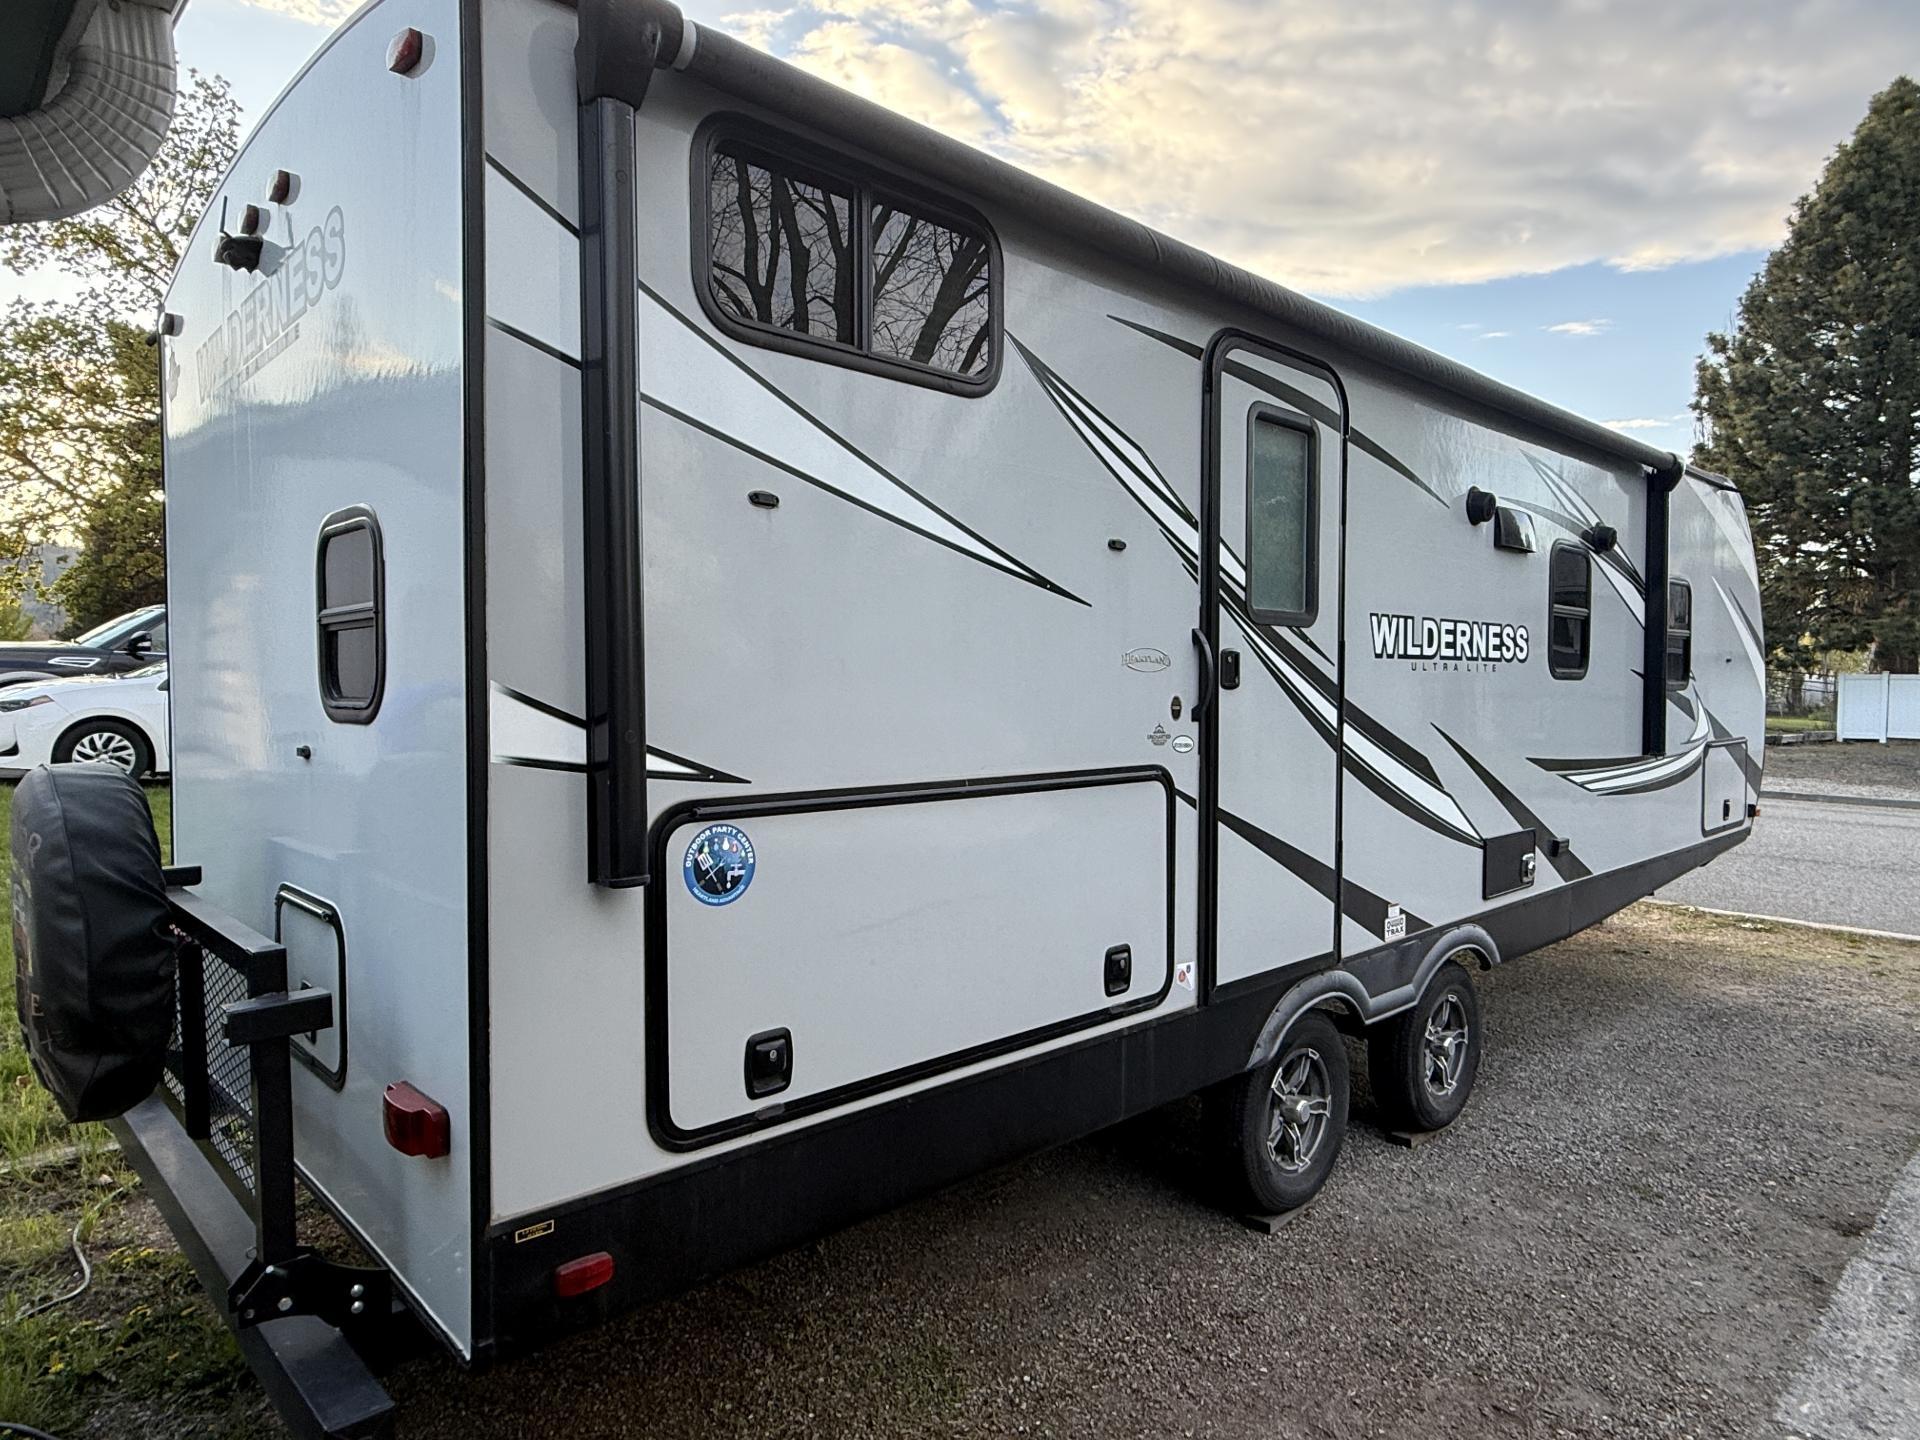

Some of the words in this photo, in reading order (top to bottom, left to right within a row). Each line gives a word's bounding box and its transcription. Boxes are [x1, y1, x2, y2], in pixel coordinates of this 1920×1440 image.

[196, 205, 346, 405] WILDERNESS
[1370, 613, 1529, 663] WILDERNESS
[685, 829, 711, 867] OUTDOOR
[712, 826, 738, 836] PARTY
[737, 833, 754, 864] CENTER
[1387, 926, 1404, 936] TRAX
